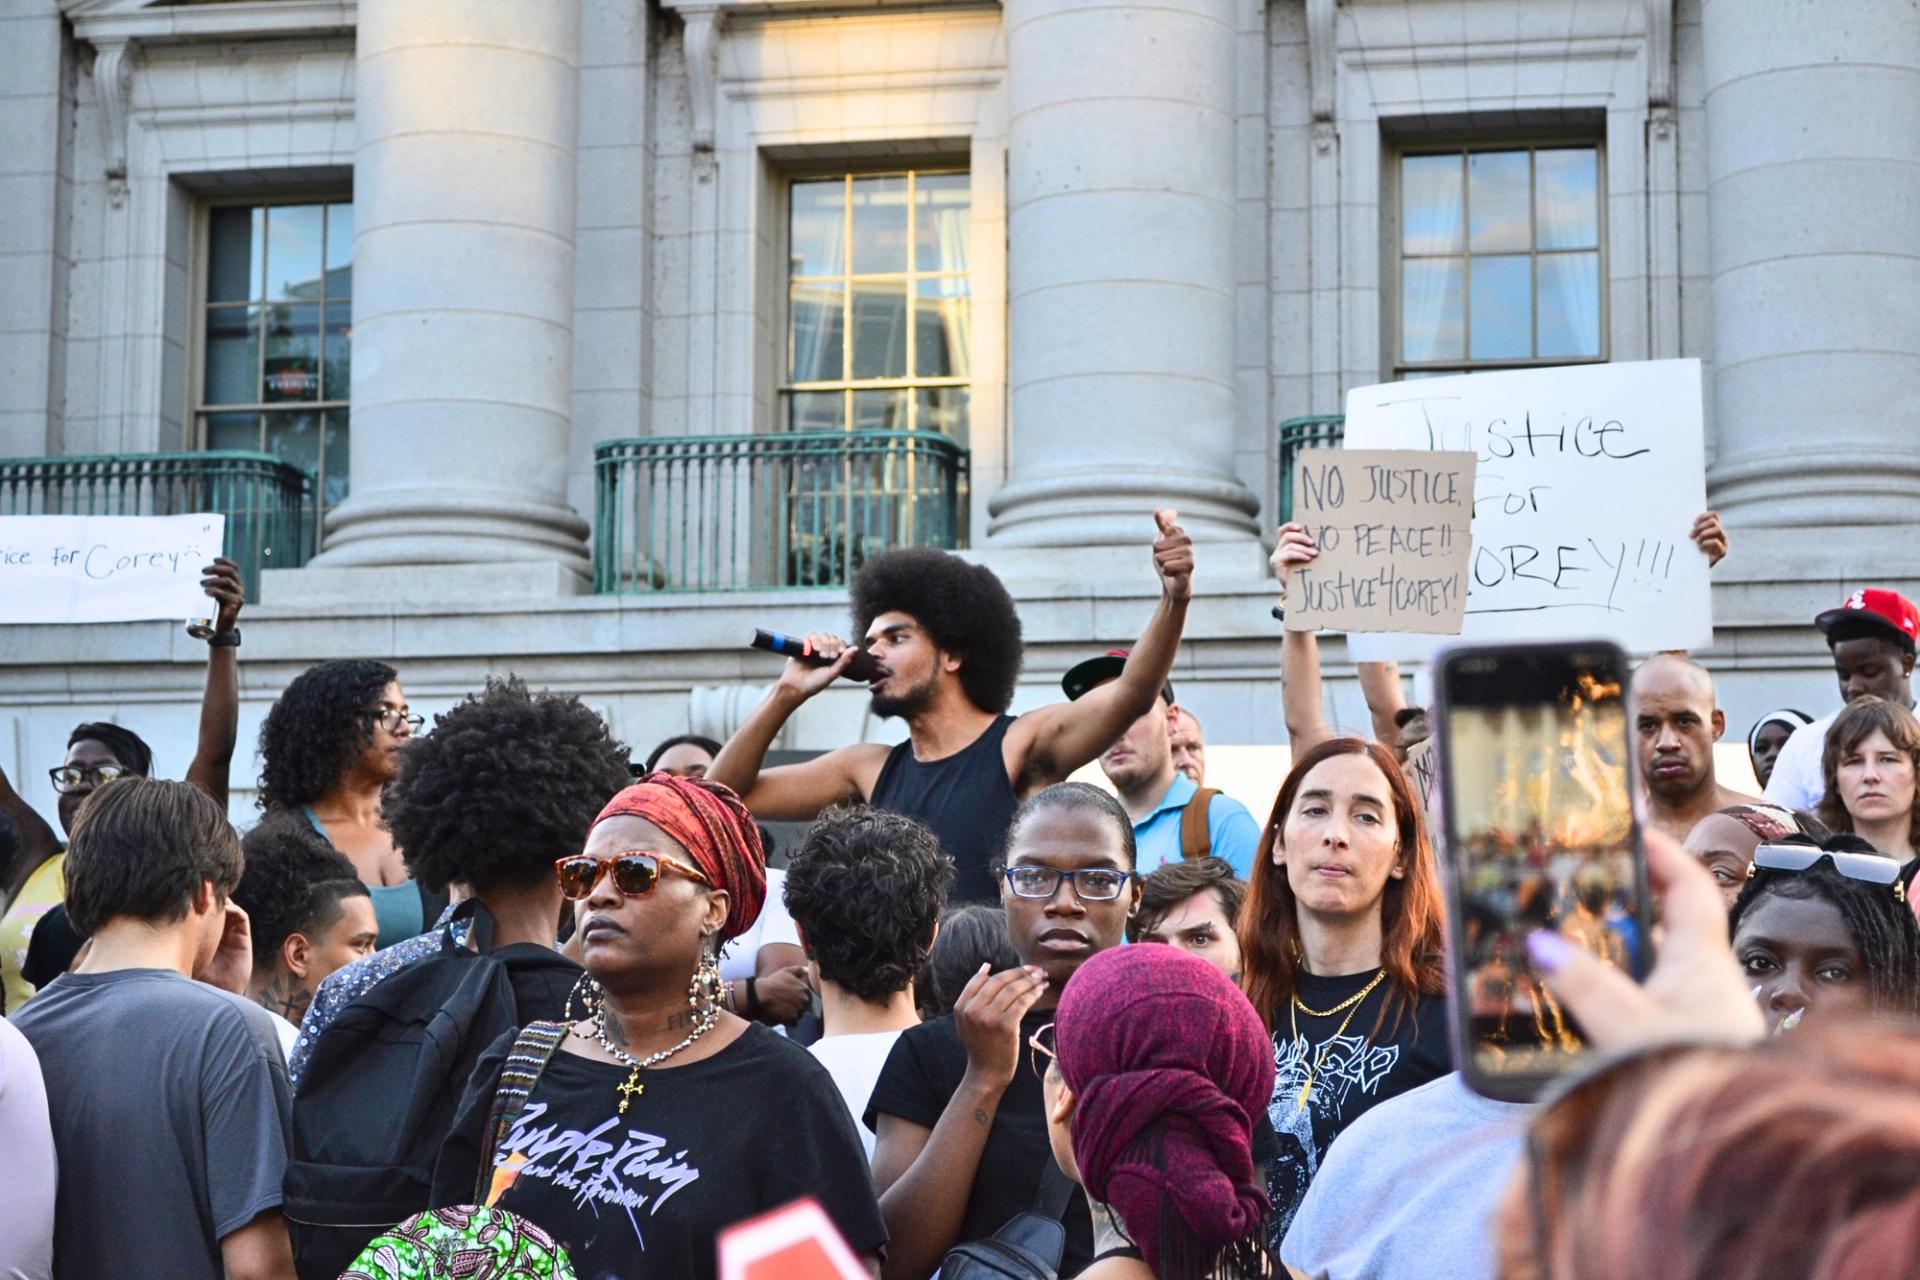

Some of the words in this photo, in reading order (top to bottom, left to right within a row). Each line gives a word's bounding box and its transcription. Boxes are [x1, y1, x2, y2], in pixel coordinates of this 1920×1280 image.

[1302, 464, 1345, 511] NO
[84, 544, 179, 579] Corey
[1354, 524, 1453, 558] PEACE!!
[1466, 537, 1675, 615] OREY!!!
